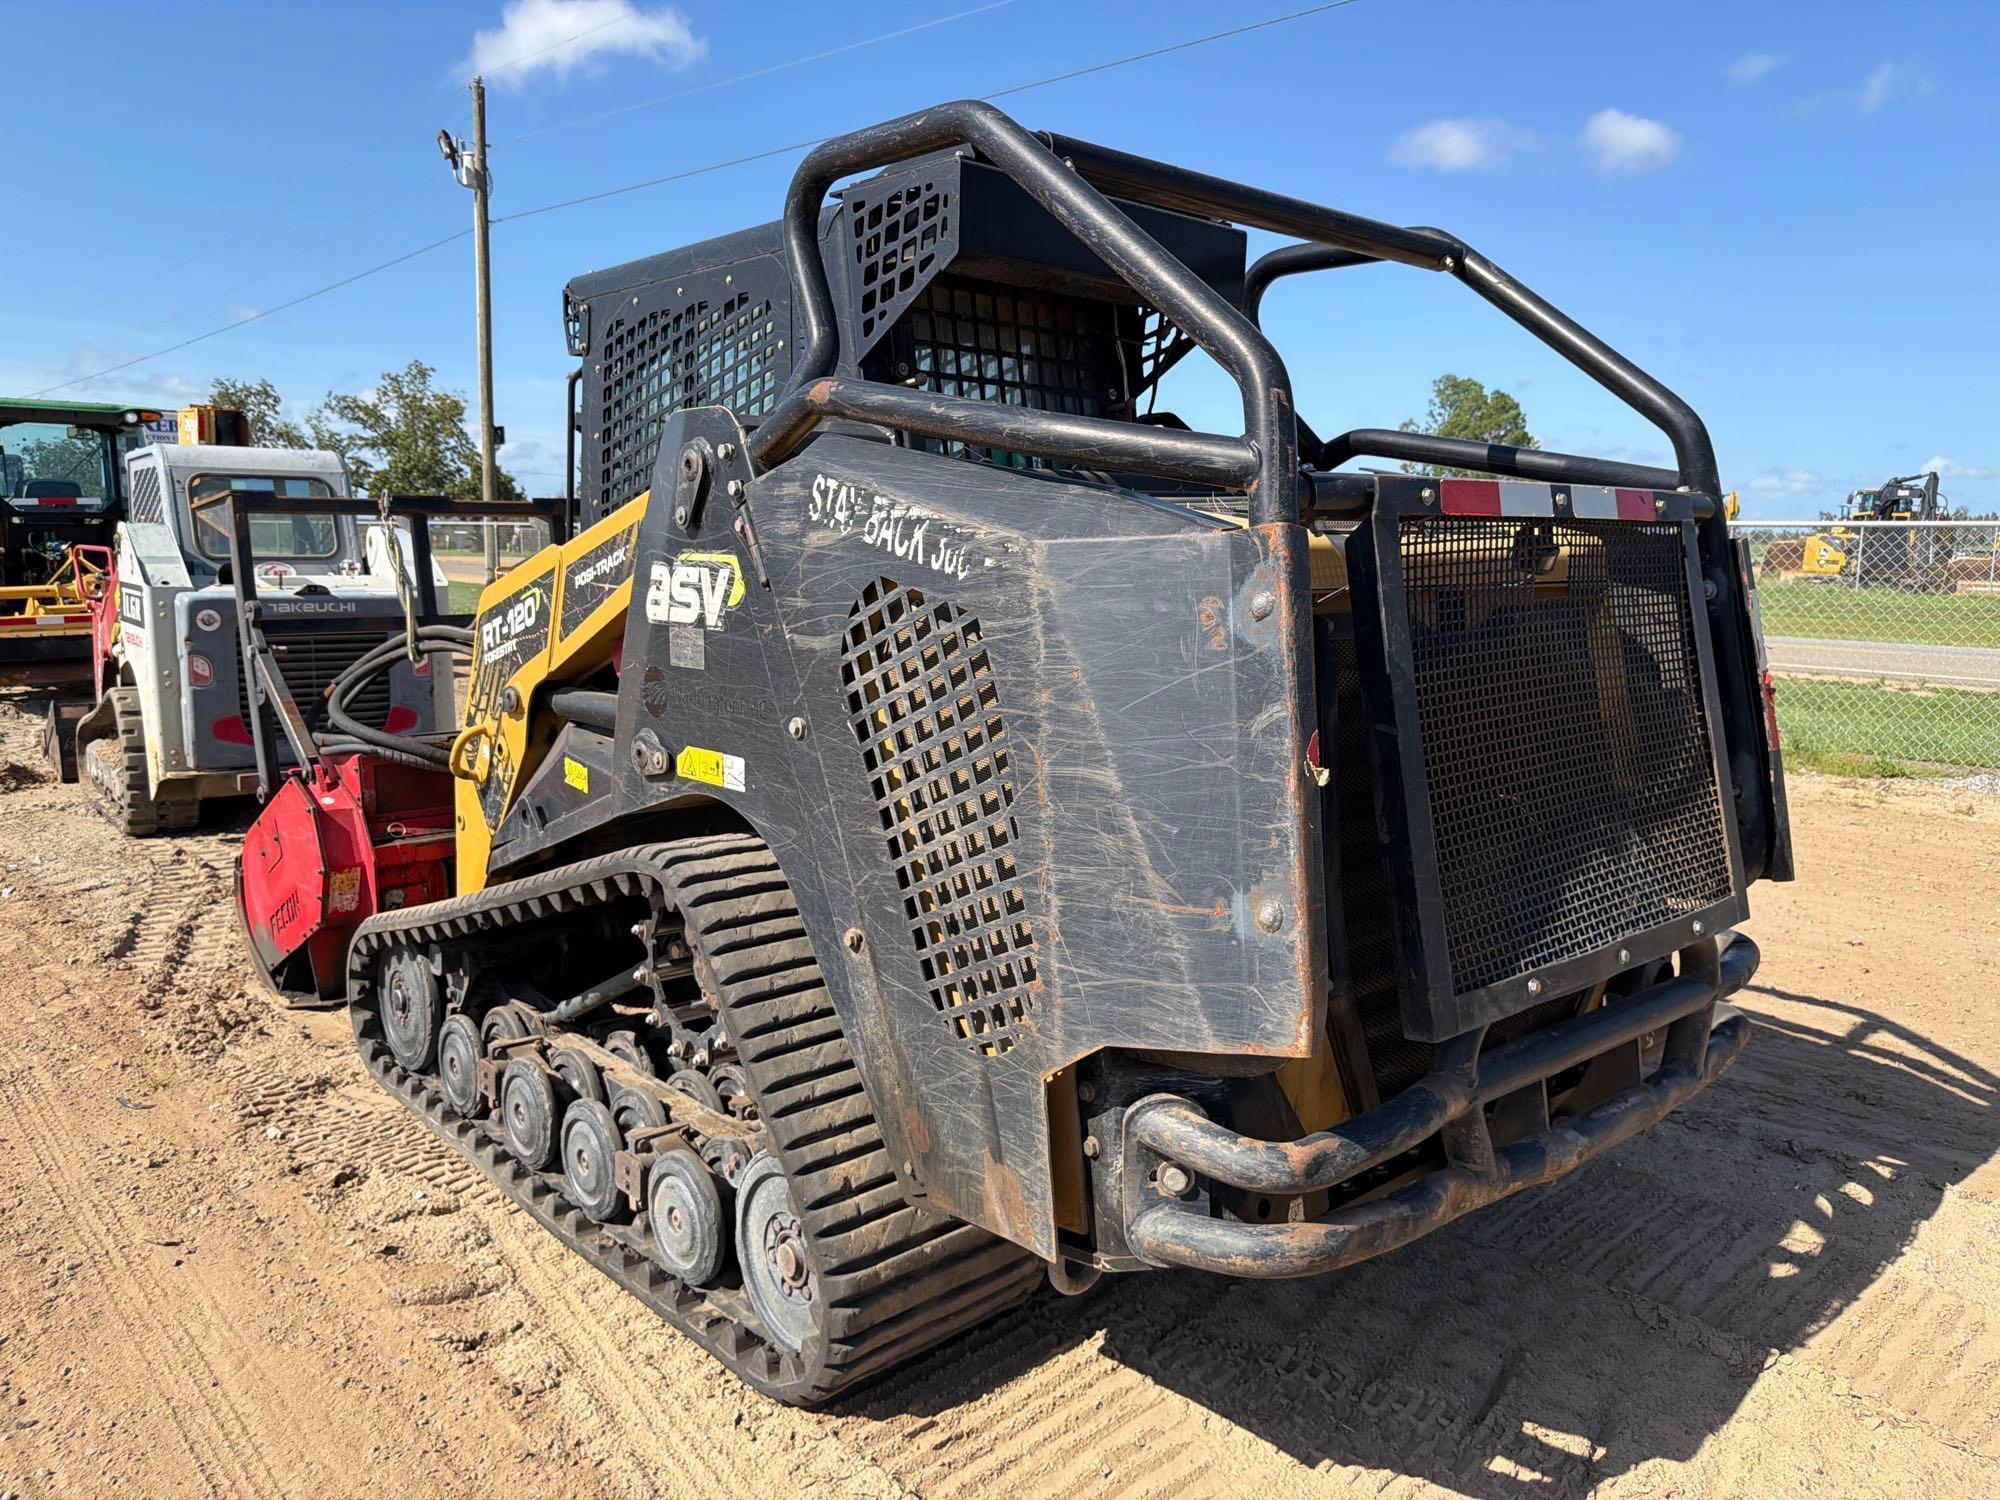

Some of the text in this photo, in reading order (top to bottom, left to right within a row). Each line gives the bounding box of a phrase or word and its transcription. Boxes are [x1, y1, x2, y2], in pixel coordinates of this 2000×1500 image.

[863, 499, 929, 564] BACK
[574, 549, 627, 589] POSI-TRACK
[482, 596, 535, 651] RT-120
[484, 638, 517, 665] FORESTRY
[269, 890, 301, 938] FECON
